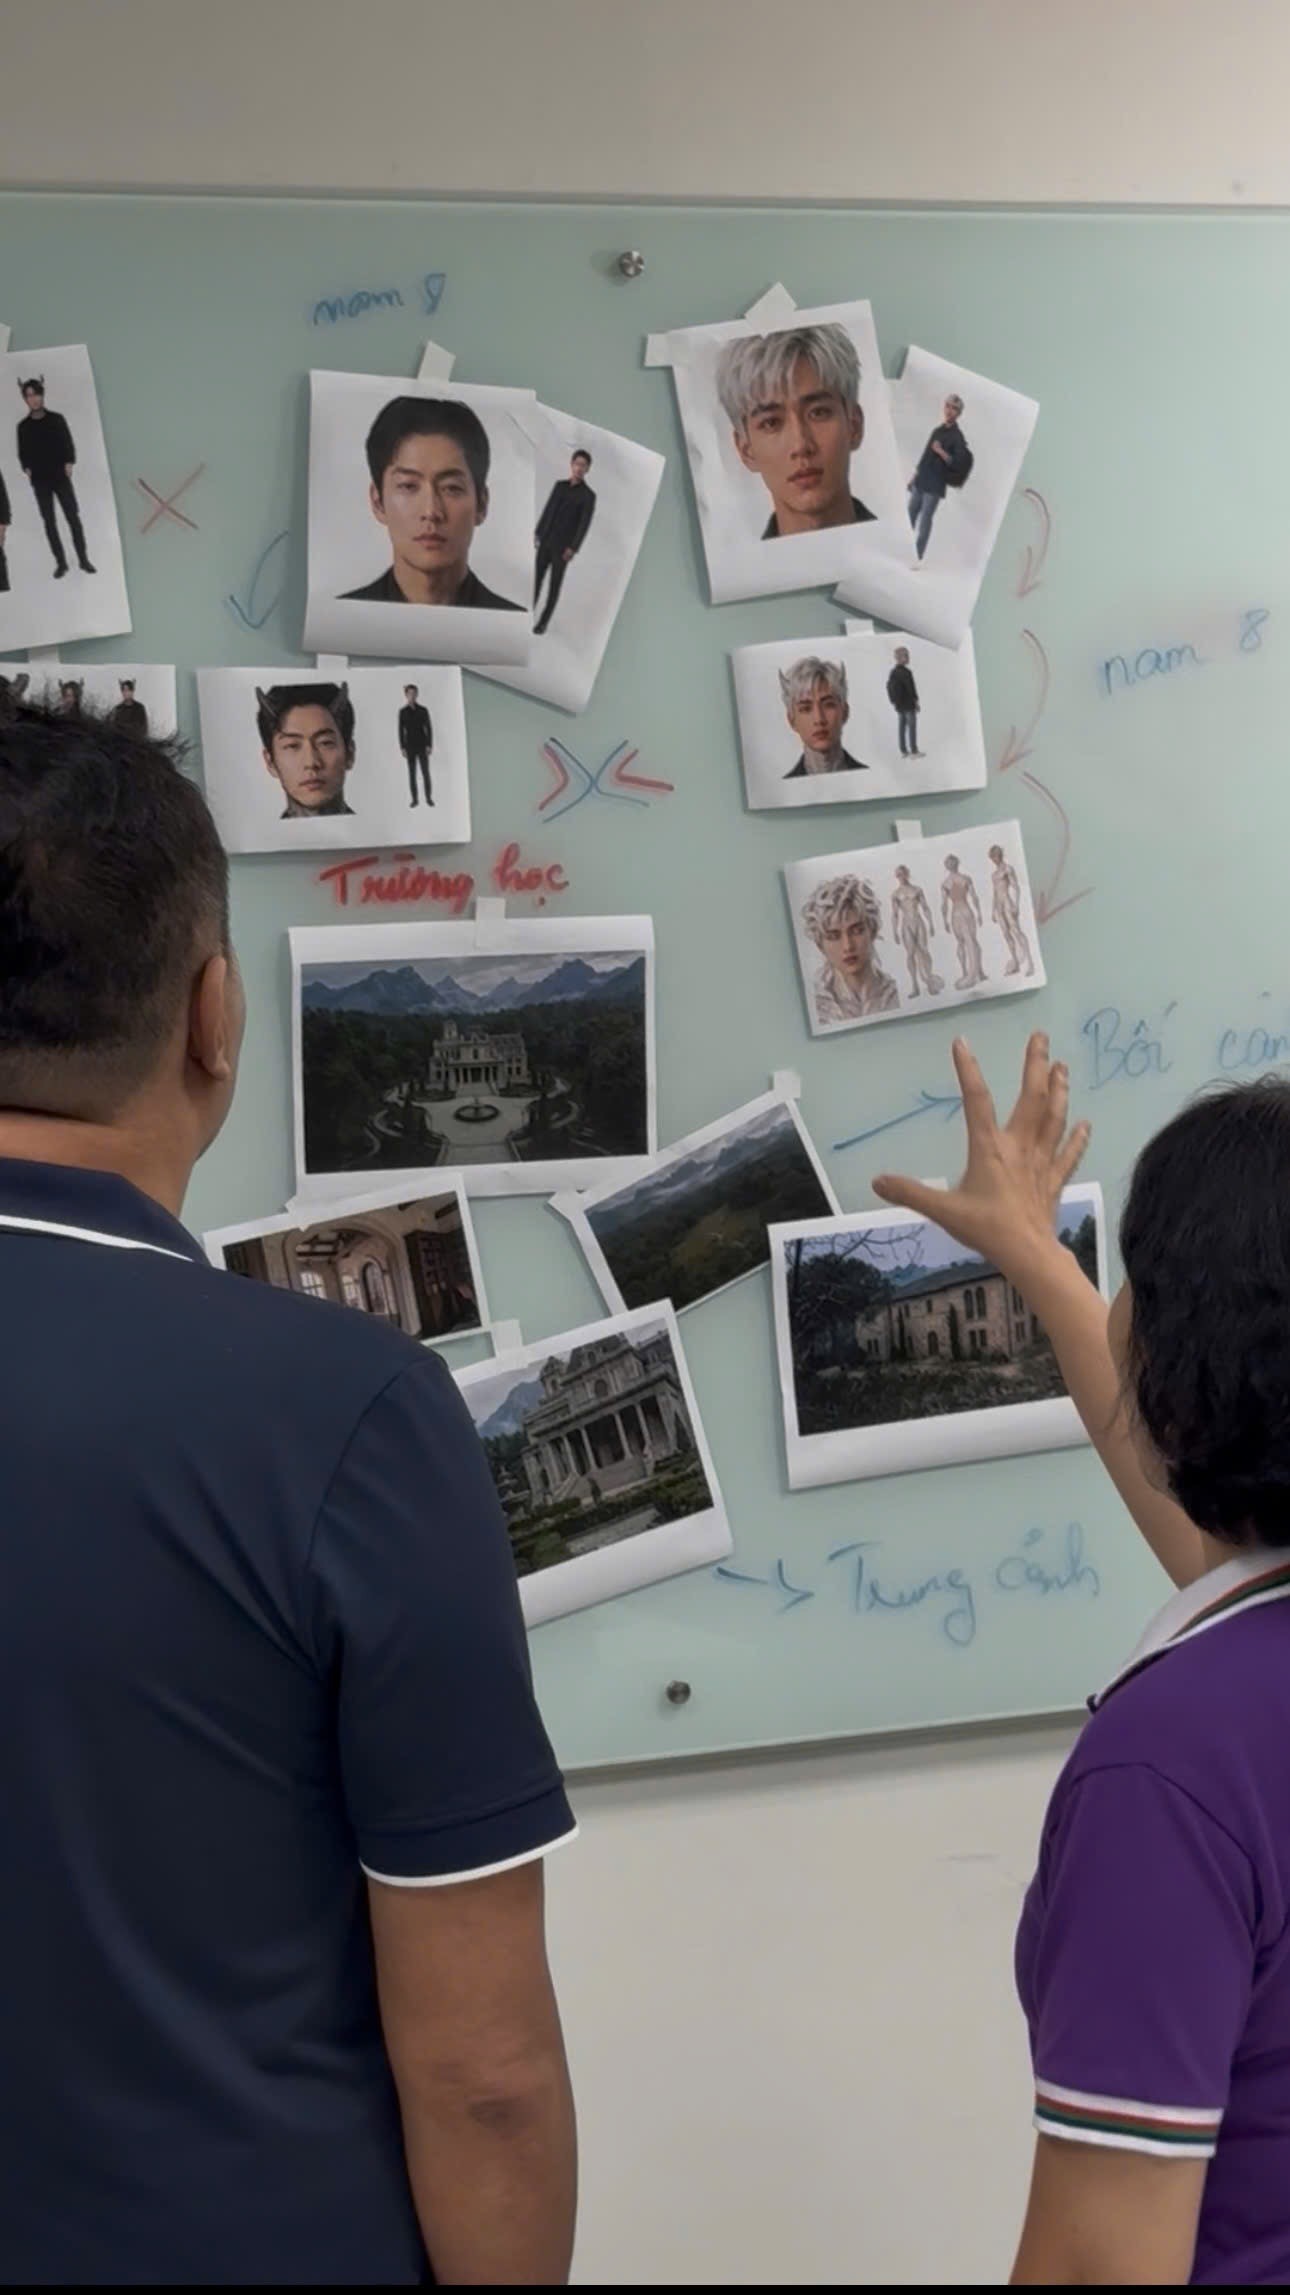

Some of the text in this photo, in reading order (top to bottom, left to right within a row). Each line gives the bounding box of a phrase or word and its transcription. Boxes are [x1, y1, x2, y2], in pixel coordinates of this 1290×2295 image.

[1103, 607, 1270, 696] nam 8
[492, 842, 570, 907] học
